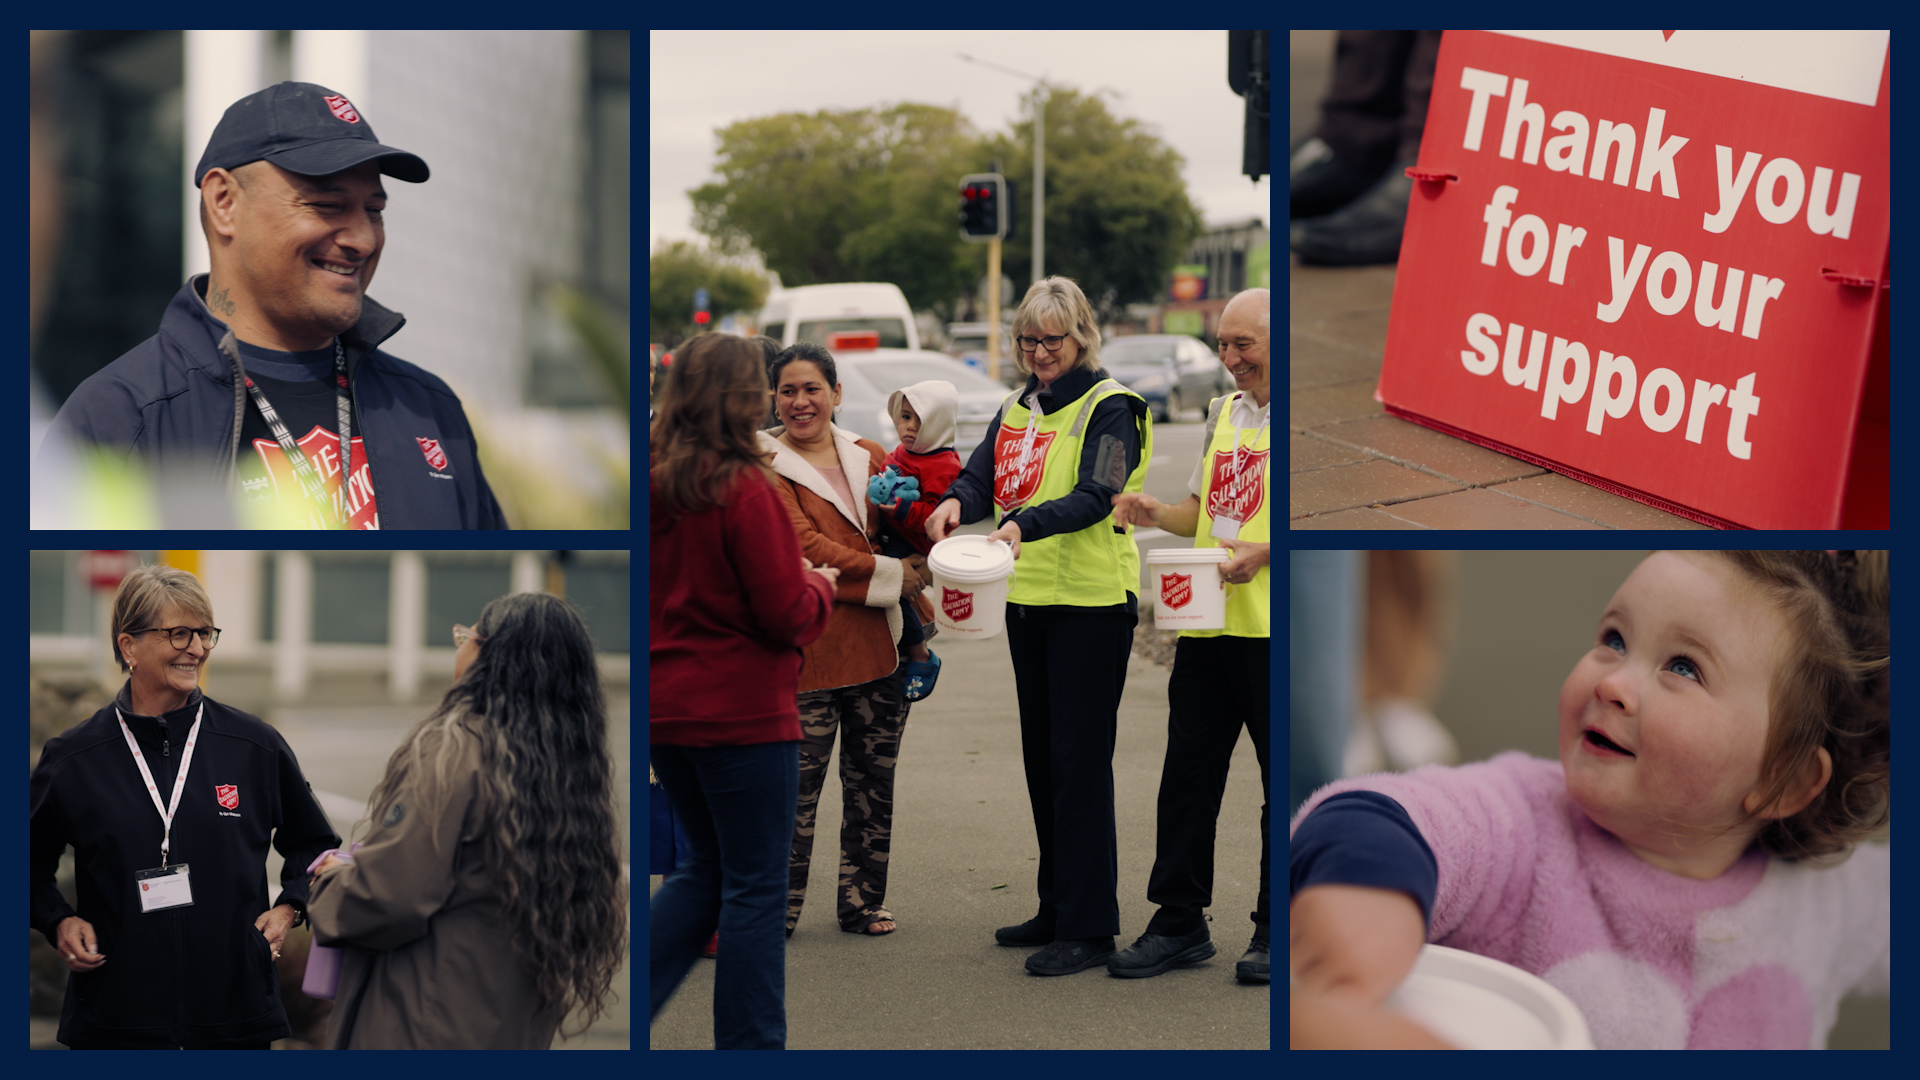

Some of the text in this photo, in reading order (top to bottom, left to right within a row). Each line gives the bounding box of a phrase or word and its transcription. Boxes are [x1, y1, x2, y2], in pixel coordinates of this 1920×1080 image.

[1459, 66, 1862, 240] Thank you
[1480, 184, 1786, 340] for your
[1459, 312, 1761, 460] support
[994, 441, 1048, 481] ALVAON
[1162, 578, 1190, 602] SALVATION
[1165, 577, 1178, 589] THE
[943, 596, 971, 611] SALVATION
[946, 593, 959, 601] THE
[1171, 588, 1189, 606] ARMY
[952, 605, 970, 618] ARMY
